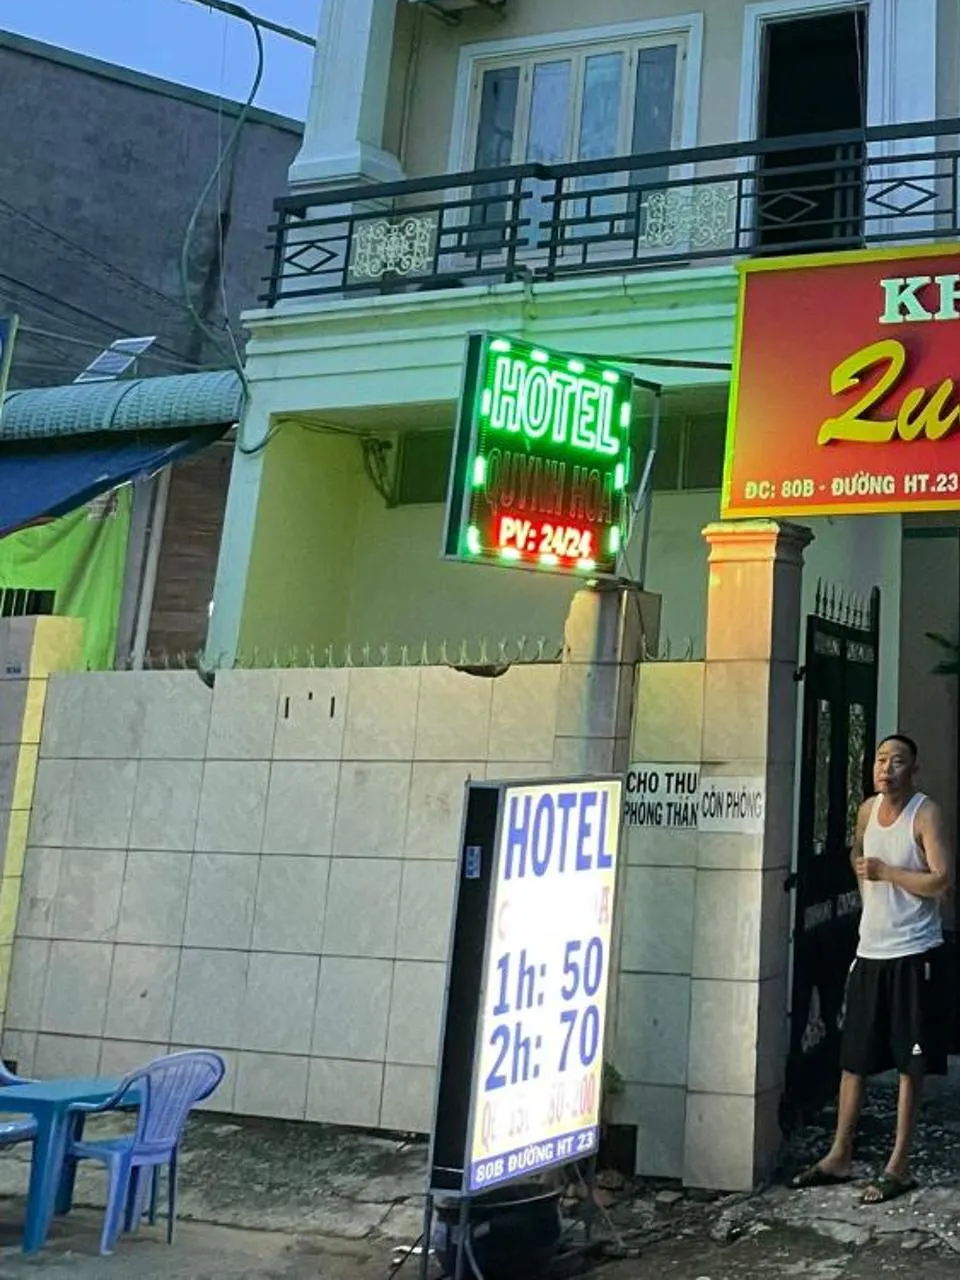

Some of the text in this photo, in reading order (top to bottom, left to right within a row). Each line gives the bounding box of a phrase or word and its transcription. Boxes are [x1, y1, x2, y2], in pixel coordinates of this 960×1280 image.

[491, 356, 620, 455] HOTEL
[745, 480, 776, 500] ĐC:
[781, 479, 815, 498] 80B
[831, 471, 895, 496] ĐƯỜNG
[904, 472, 959, 493] HT.23
[499, 517, 592, 558] PV: 24/24
[626, 771, 659, 794] CHO
[504, 791, 613, 881] HOTEL
[493, 936, 604, 1016] 1h: 50
[484, 1004, 600, 1092] 2h: 70
[475, 1158, 504, 1183] 80B
[556, 1135, 574, 1157] HT
[576, 1130, 594, 1151] 23
